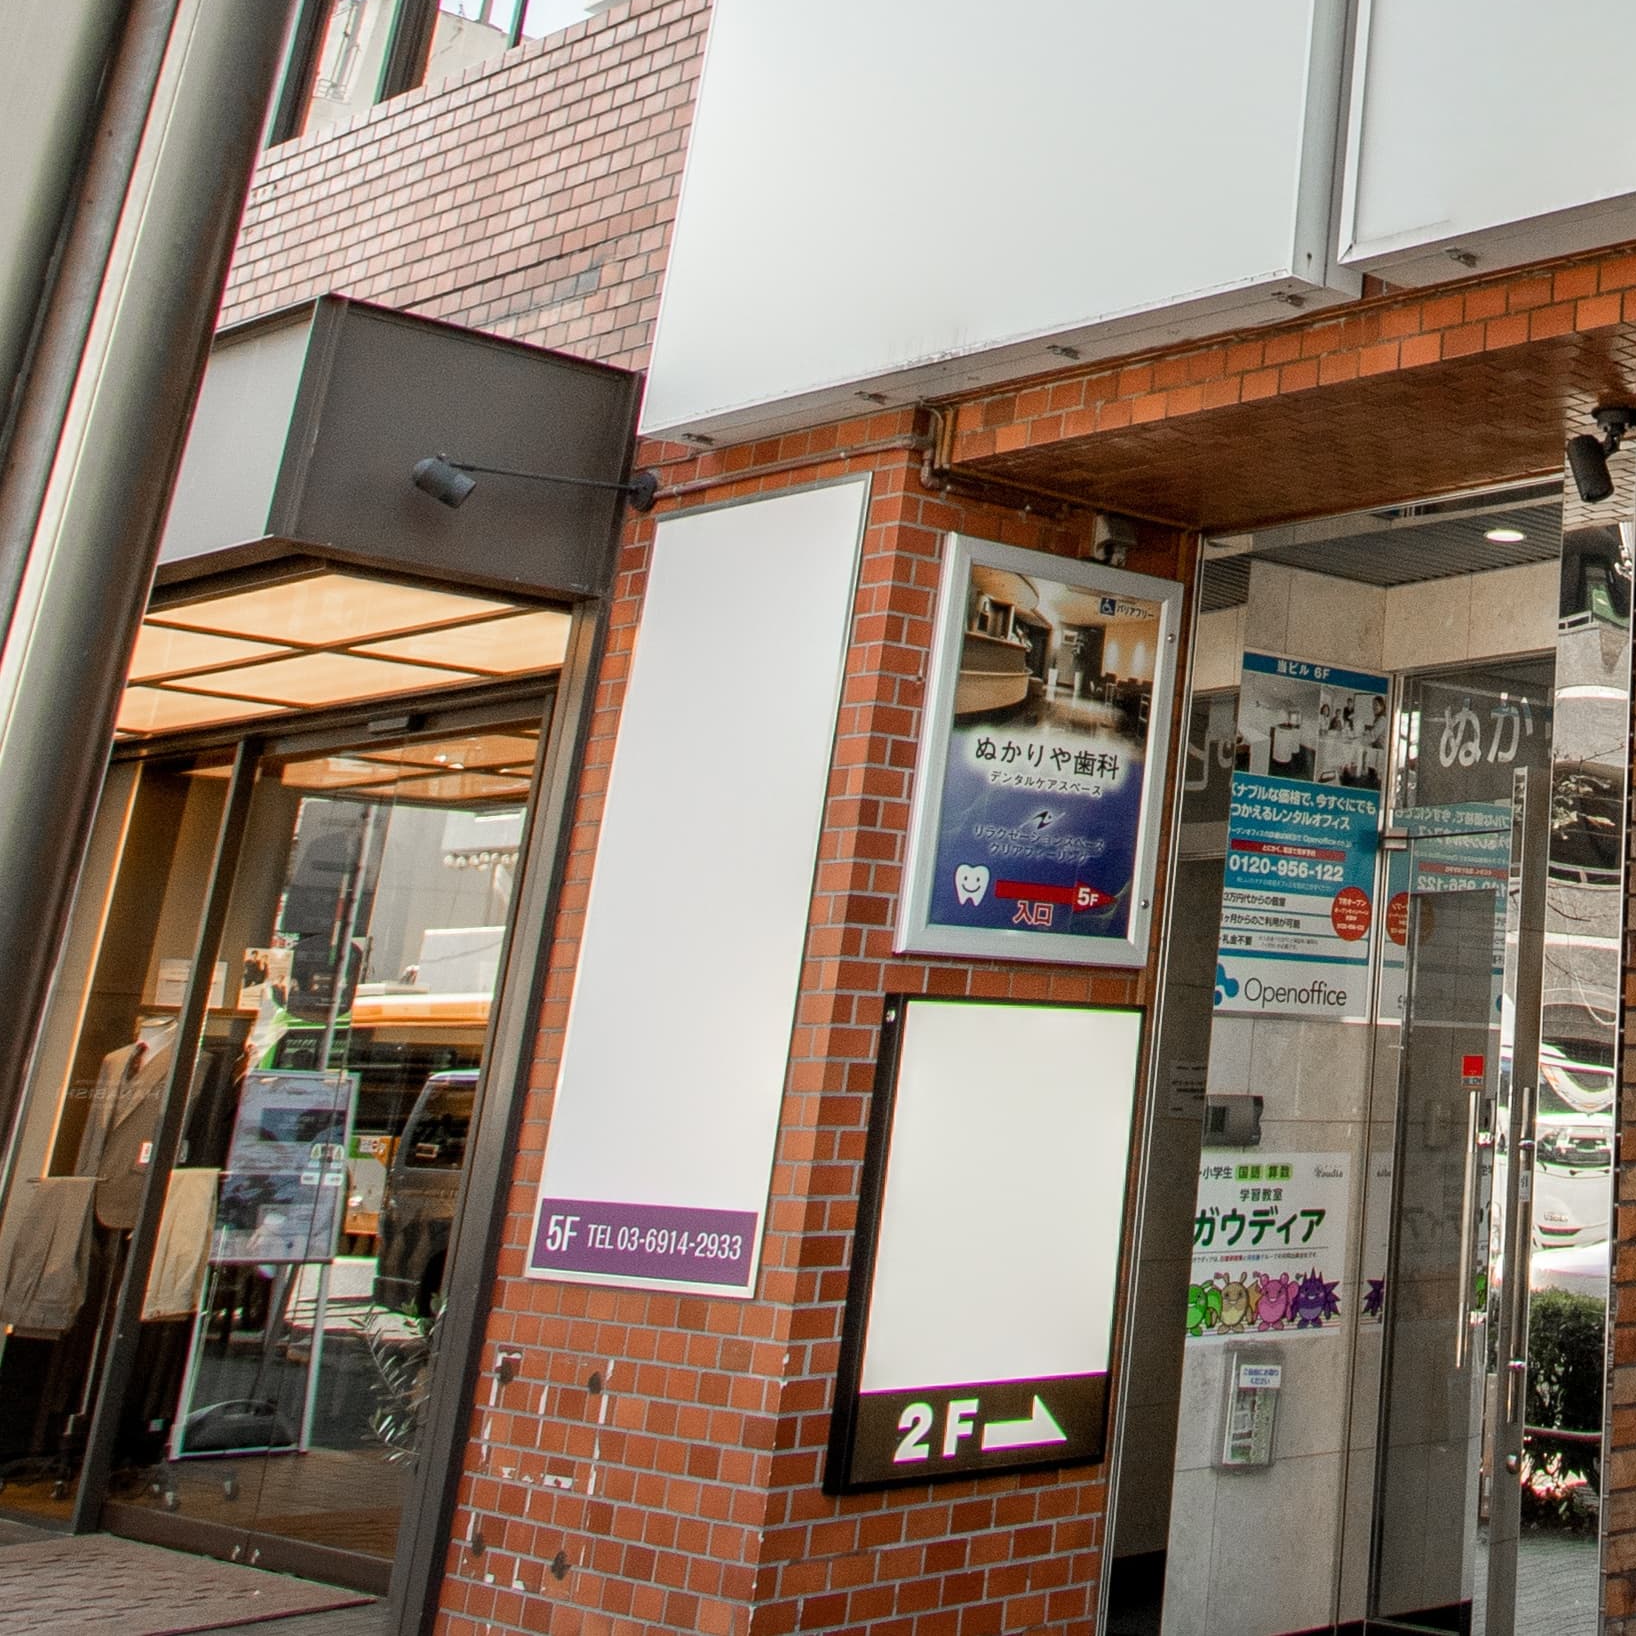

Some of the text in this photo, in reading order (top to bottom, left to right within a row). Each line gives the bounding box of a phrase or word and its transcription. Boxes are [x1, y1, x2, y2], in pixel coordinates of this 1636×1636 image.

[975, 736, 1120, 780] ぬかりや歯科
[990, 770, 1102, 796] デンタルケアスペース
[1229, 854, 1344, 882] 0120-956-122
[1077, 887, 1099, 906] 5F
[1012, 900, 1054, 926] 入口
[1244, 977, 1347, 1008] Openoffice
[1240, 1188, 1283, 1202] 学習教室
[545, 1215, 742, 1260] 5F TEL 03-6914-2933
[1193, 1205, 1326, 1247] ガウディア
[893, 1397, 980, 1464] 2F
